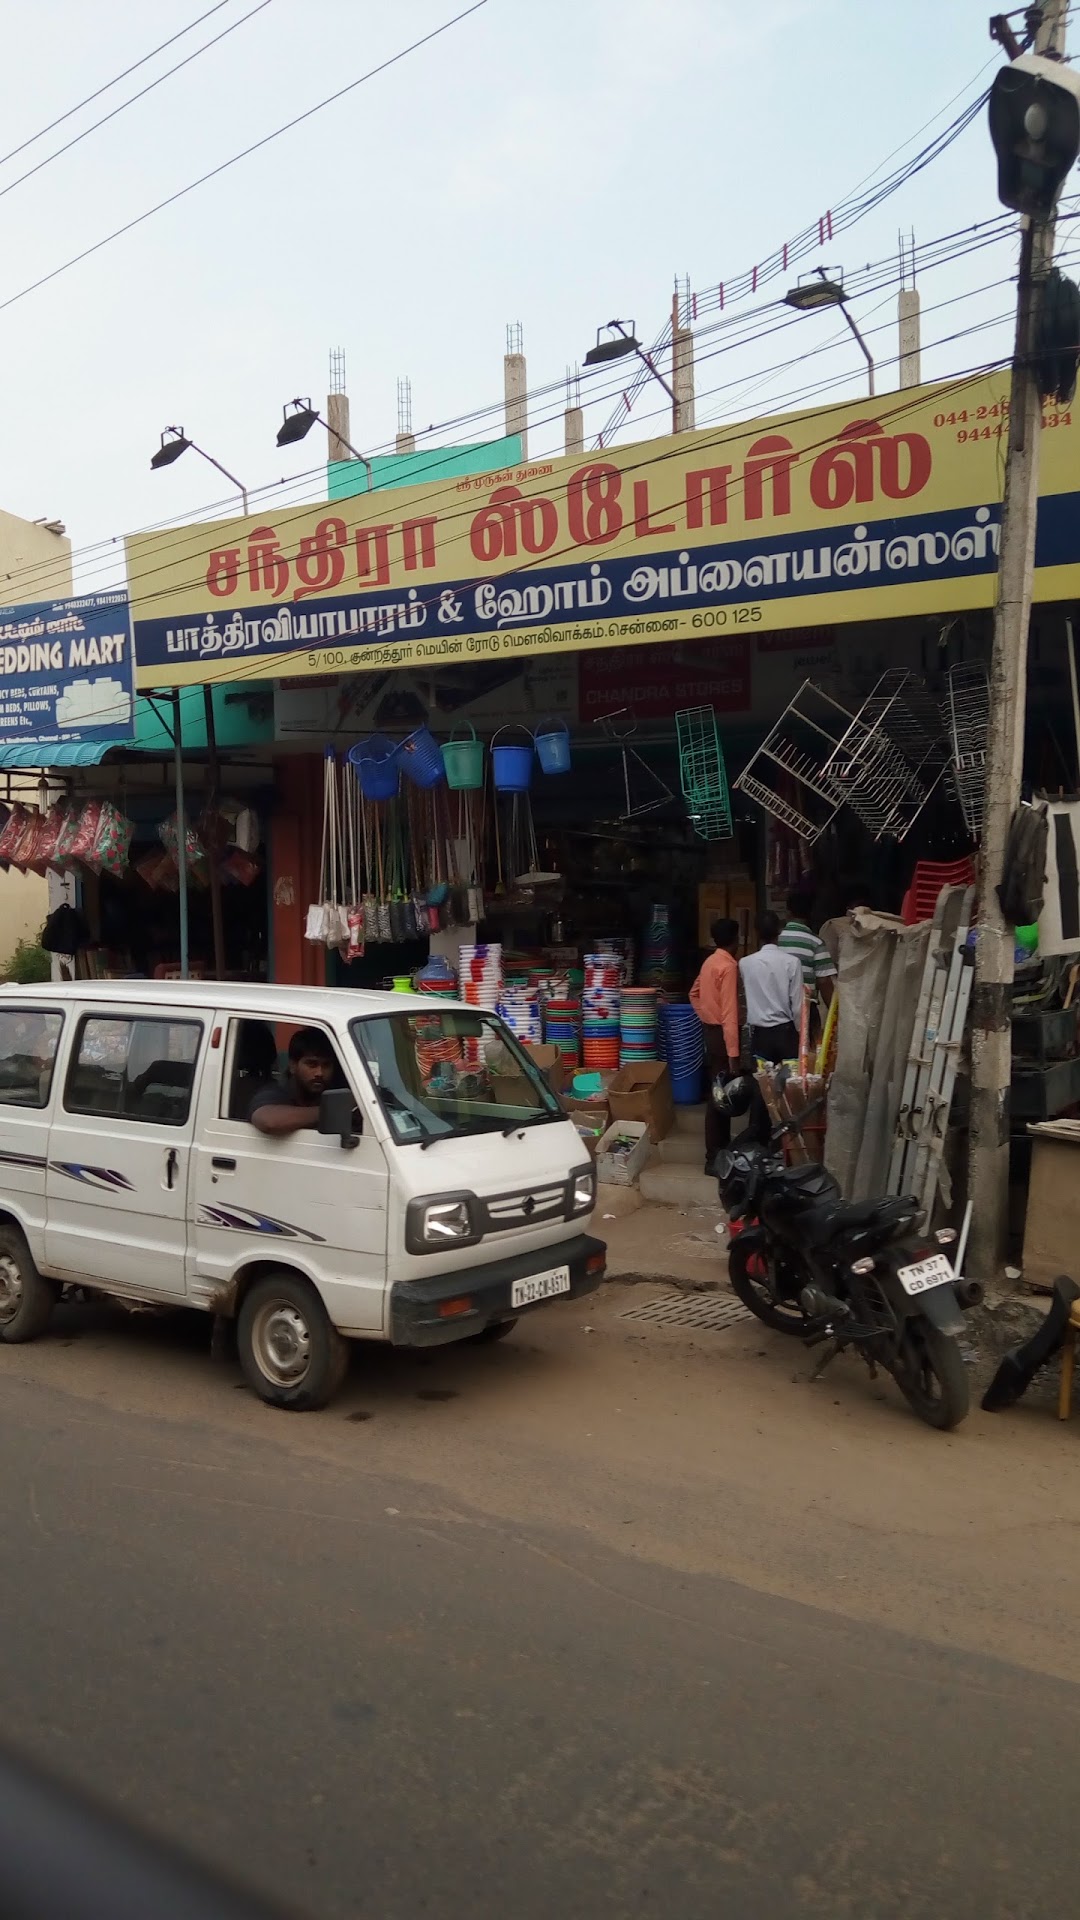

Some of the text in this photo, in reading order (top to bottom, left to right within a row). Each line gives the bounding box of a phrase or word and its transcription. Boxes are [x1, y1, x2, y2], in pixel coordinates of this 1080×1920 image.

[473, 469, 513, 490] முருகன்
[516, 464, 553, 482] துணை
[206, 419, 932, 602] சந்திரா ஸ்டோர்ஸ்
[166, 589, 428, 657] பாத்திரவியாபாரம்
[437, 589, 464, 624] &
[475, 563, 612, 630] ஹோம்
[416, 639, 463, 656] மெயின்
[465, 635, 500, 653] ரோடு
[692, 611, 727, 628] 600
[733, 606, 762, 623] 125
[68, 633, 126, 668] MART
[28, 684, 59, 697] CURTAINS,
[585, 679, 744, 705] CHANDRA STORES
[5, 702, 22, 713] BEDS,
[23, 700, 51, 712] PILLOWS,
[908, 1260, 939, 1277] TN 37
[908, 1271, 951, 1291] CD 6971
